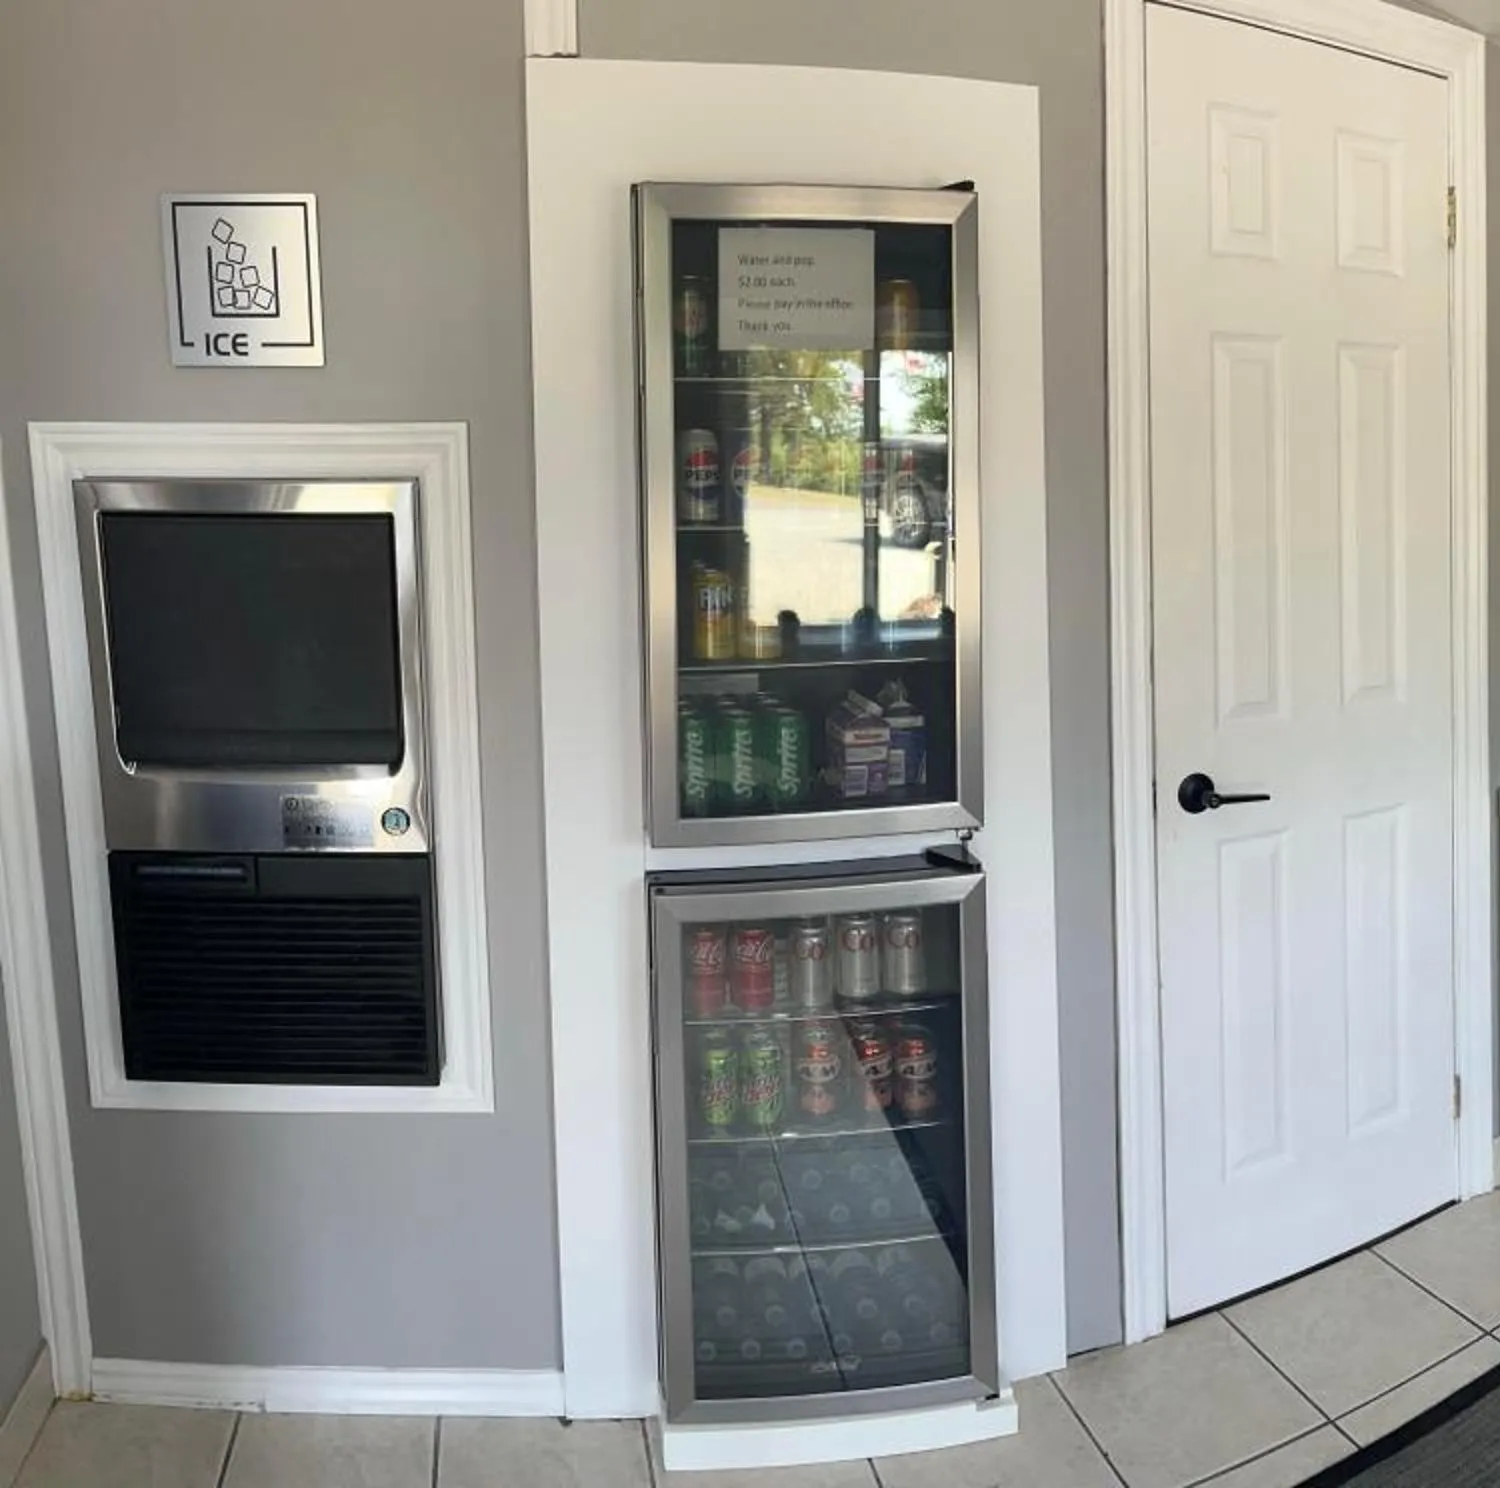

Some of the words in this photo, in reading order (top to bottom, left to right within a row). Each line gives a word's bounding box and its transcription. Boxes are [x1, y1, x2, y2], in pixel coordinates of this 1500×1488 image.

[737, 254, 769, 267] Water
[772, 254, 792, 267] and
[738, 276, 767, 288] $2.00
[737, 298, 771, 310] Please
[773, 300, 793, 312] pay
[737, 319, 768, 331] Thank
[205, 333, 249, 357] ICE
[684, 730, 709, 799] Sprite
[732, 729, 757, 799] Sprite
[776, 727, 801, 797] Sprite
